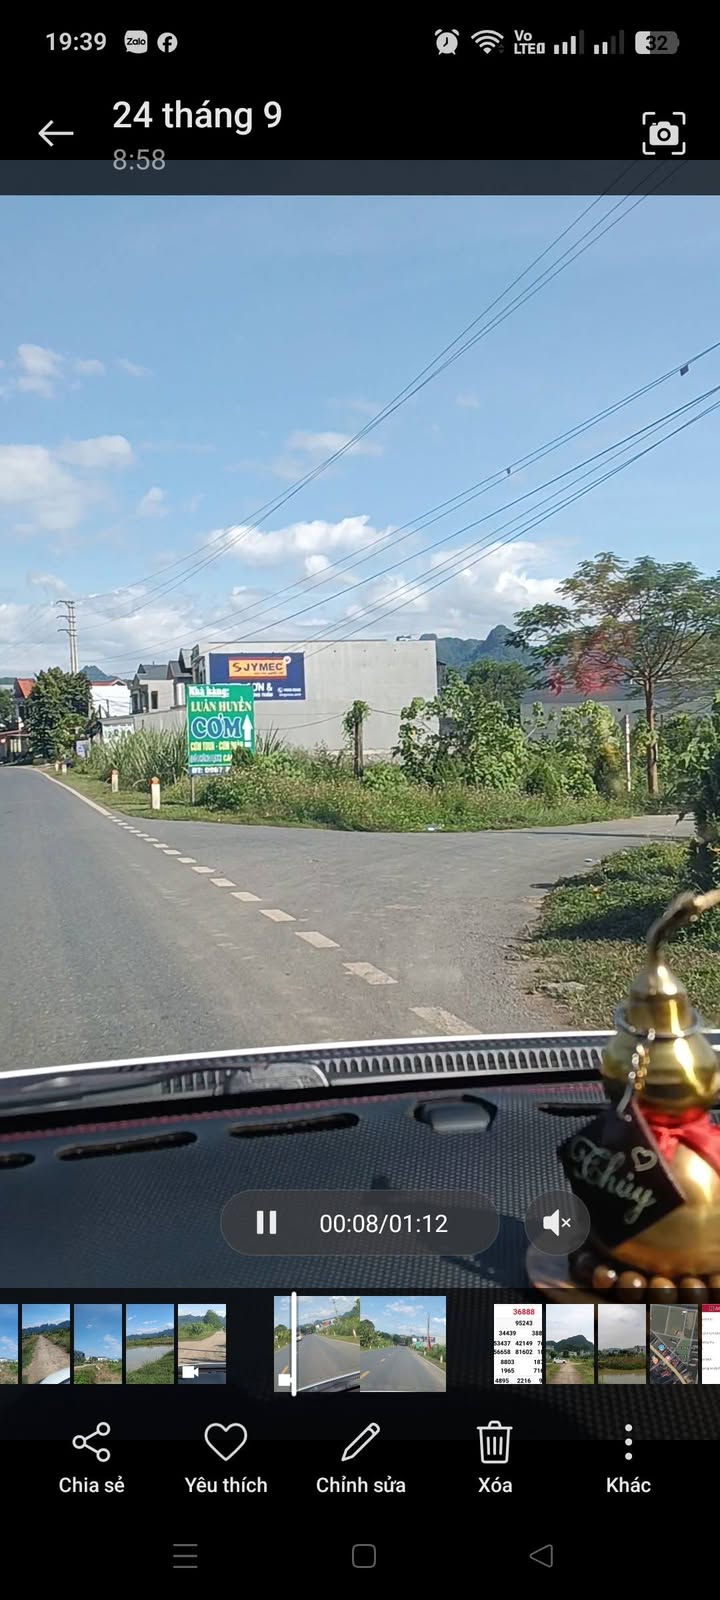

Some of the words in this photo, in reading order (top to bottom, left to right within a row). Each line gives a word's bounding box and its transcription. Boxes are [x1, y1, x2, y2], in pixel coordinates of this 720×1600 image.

[46, 32, 107, 51] 19:39
[126, 37, 146, 45] Zalo
[645, 34, 669, 51] 32
[112, 100, 153, 128] 24
[161, 99, 253, 136] tháng
[263, 100, 282, 128] 9
[112, 148, 166, 171] 8:58
[191, 712, 243, 739] CƠM
[319, 1213, 449, 1236] 00:08/01:12
[58, 1476, 99, 1493] Chia
[104, 1475, 125, 1493] sẻ
[185, 1476, 218, 1493] Yêu
[222, 1476, 268, 1493] thích
[316, 1475, 368, 1493] Chỉnh
[374, 1475, 406, 1493] sửa
[478, 1476, 513, 1493] Xóa
[606, 1476, 652, 1493] Khác
